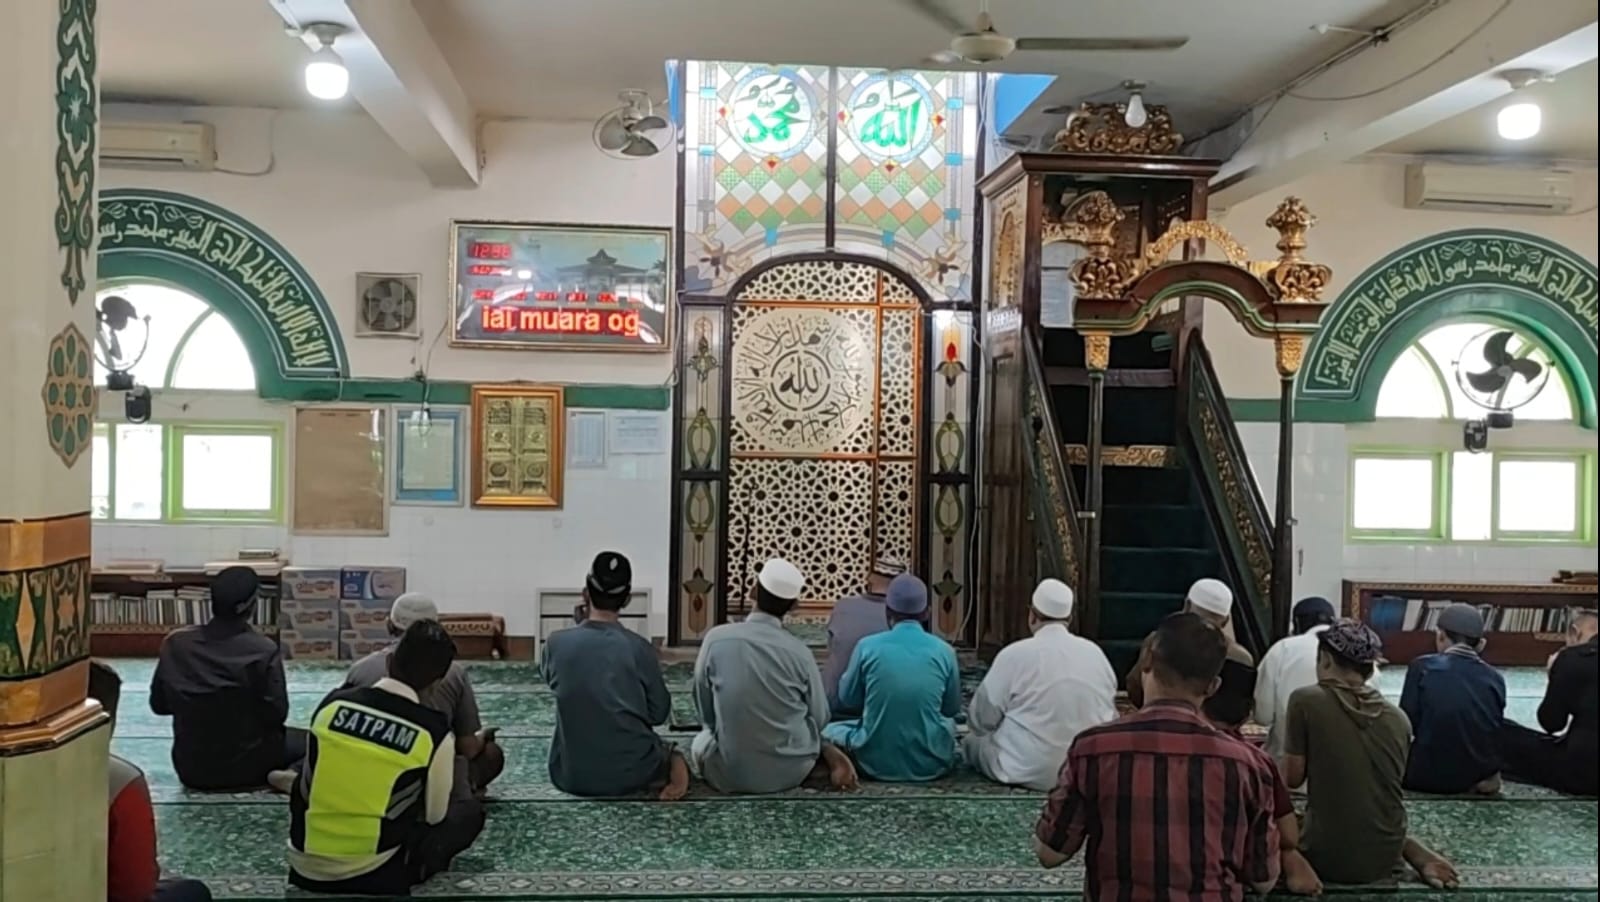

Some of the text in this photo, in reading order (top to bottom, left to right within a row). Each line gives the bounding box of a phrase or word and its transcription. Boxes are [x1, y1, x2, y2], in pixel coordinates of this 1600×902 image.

[859, 100, 922, 148] الله
[520, 311, 600, 332] muara
[333, 708, 416, 749] SATPAM
